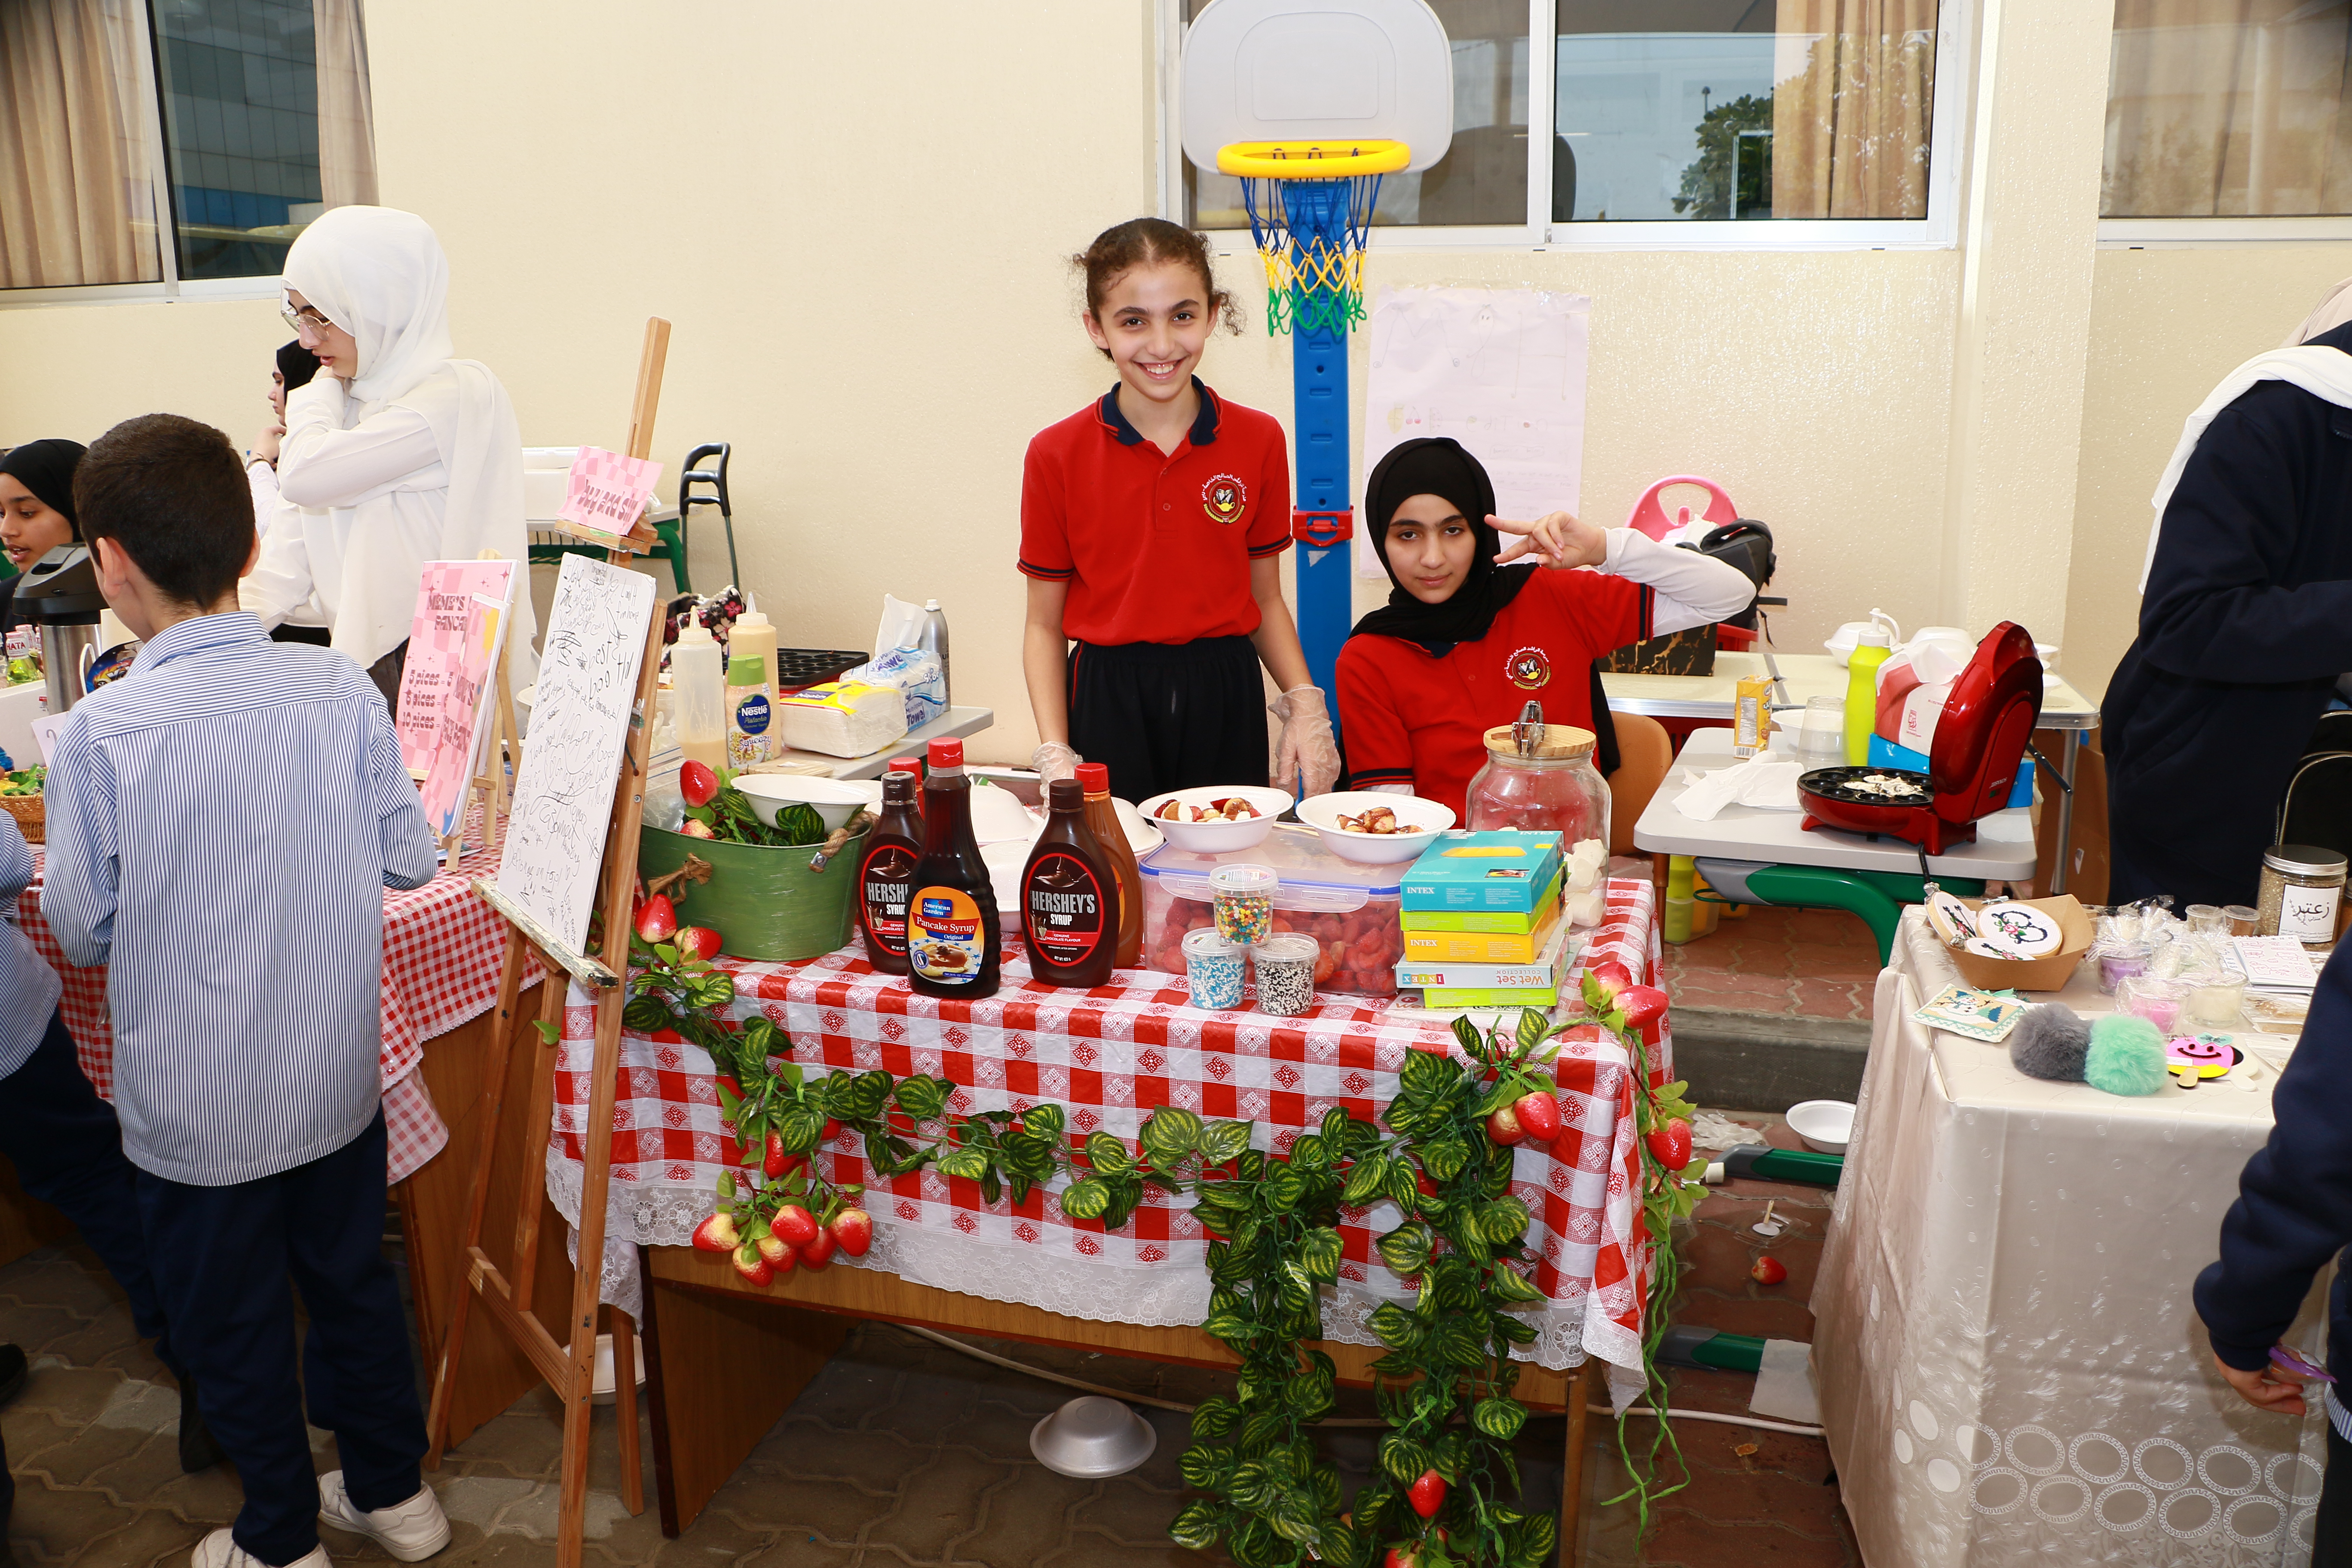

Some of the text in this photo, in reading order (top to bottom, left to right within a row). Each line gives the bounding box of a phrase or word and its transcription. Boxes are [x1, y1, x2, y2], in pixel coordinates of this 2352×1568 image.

[577, 478, 604, 515] buy
[597, 490, 625, 518] and
[408, 669, 415, 685] 5
[413, 669, 440, 687] pices
[411, 690, 435, 708] pices
[402, 711, 411, 727] 10
[411, 712, 435, 729] pices
[744, 716, 767, 724] Pistachio
[739, 735, 772, 751] Squeezy
[886, 904, 906, 915] SYRU
[923, 902, 950, 911] American
[1032, 890, 1096, 914] HERSHEY'S
[2292, 901, 2330, 919] زعتر
[923, 907, 944, 916] Garden
[1050, 913, 1072, 925] SYRUP
[916, 916, 974, 933] Pancake Syrup
[1403, 975, 1443, 983] INTEX
[1496, 975, 1545, 985] Wet Set
